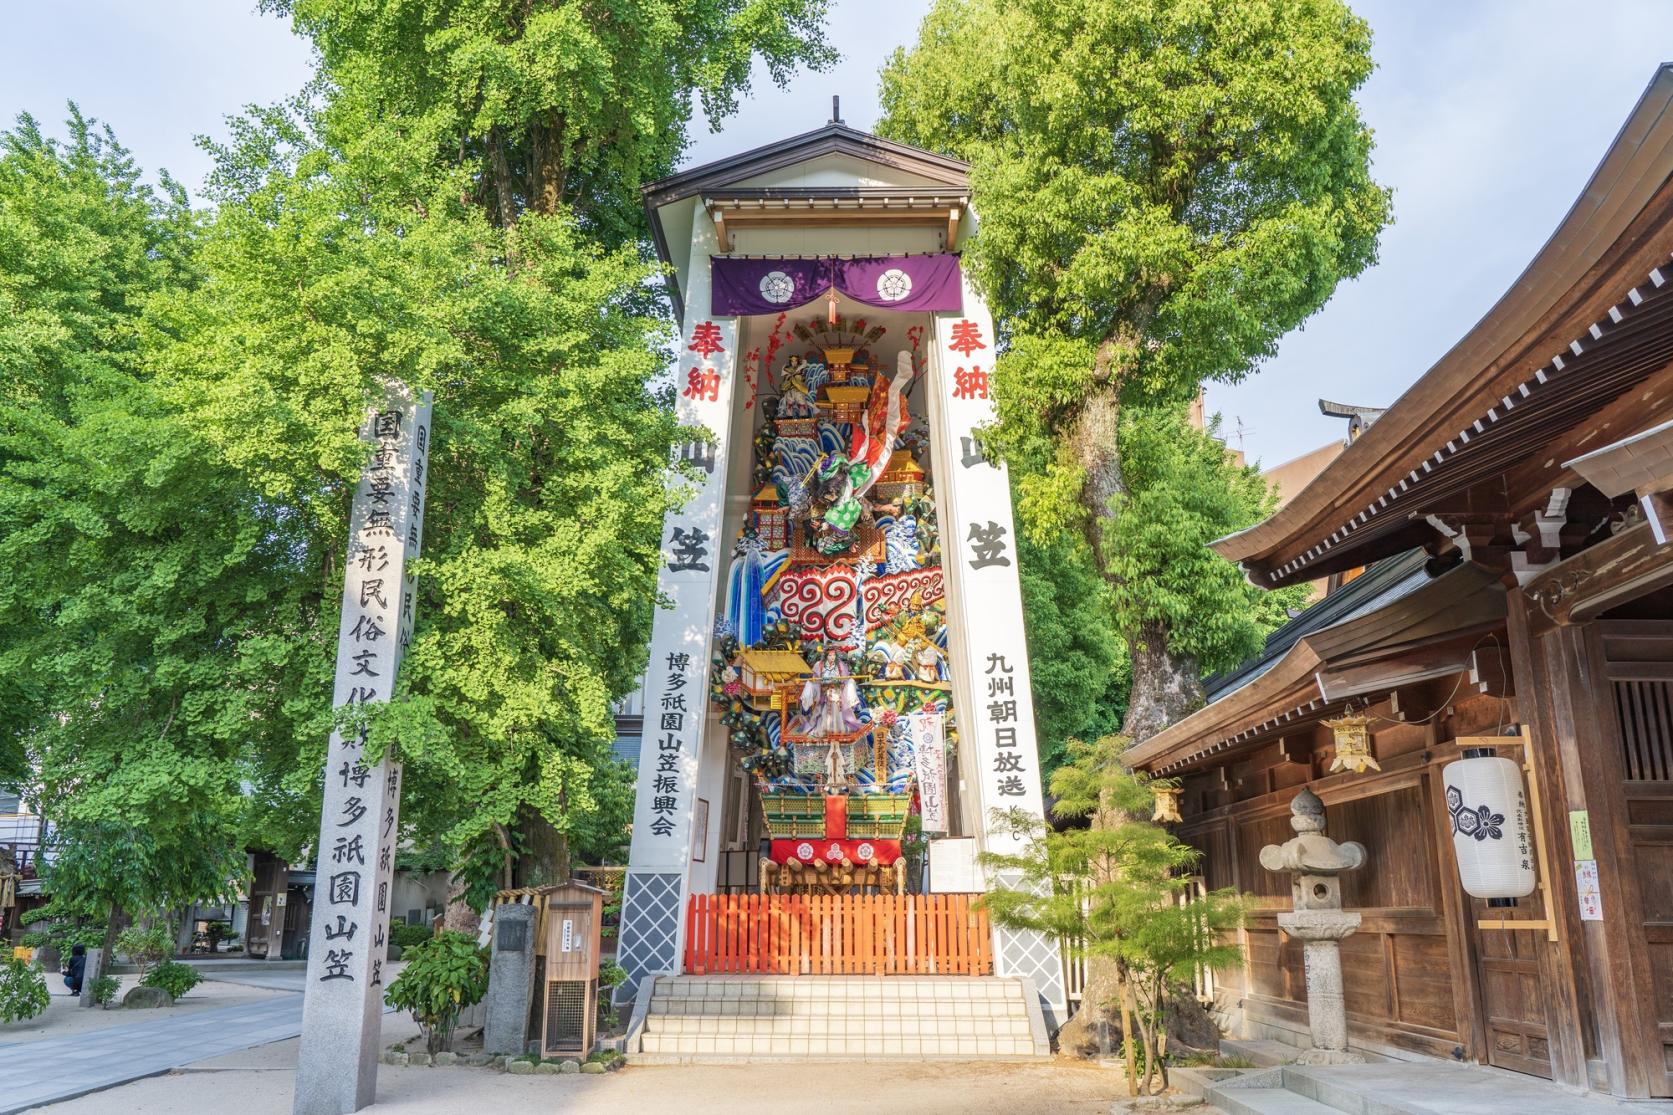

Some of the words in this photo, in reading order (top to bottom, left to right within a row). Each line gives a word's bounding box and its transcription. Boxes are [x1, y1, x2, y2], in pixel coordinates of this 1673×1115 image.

[683, 320, 725, 402] 奉納
[948, 319, 988, 400] 奉納
[649, 651, 690, 837] 博多祇園山笠振興会
[985, 652, 1027, 797] 九州朝日放送
